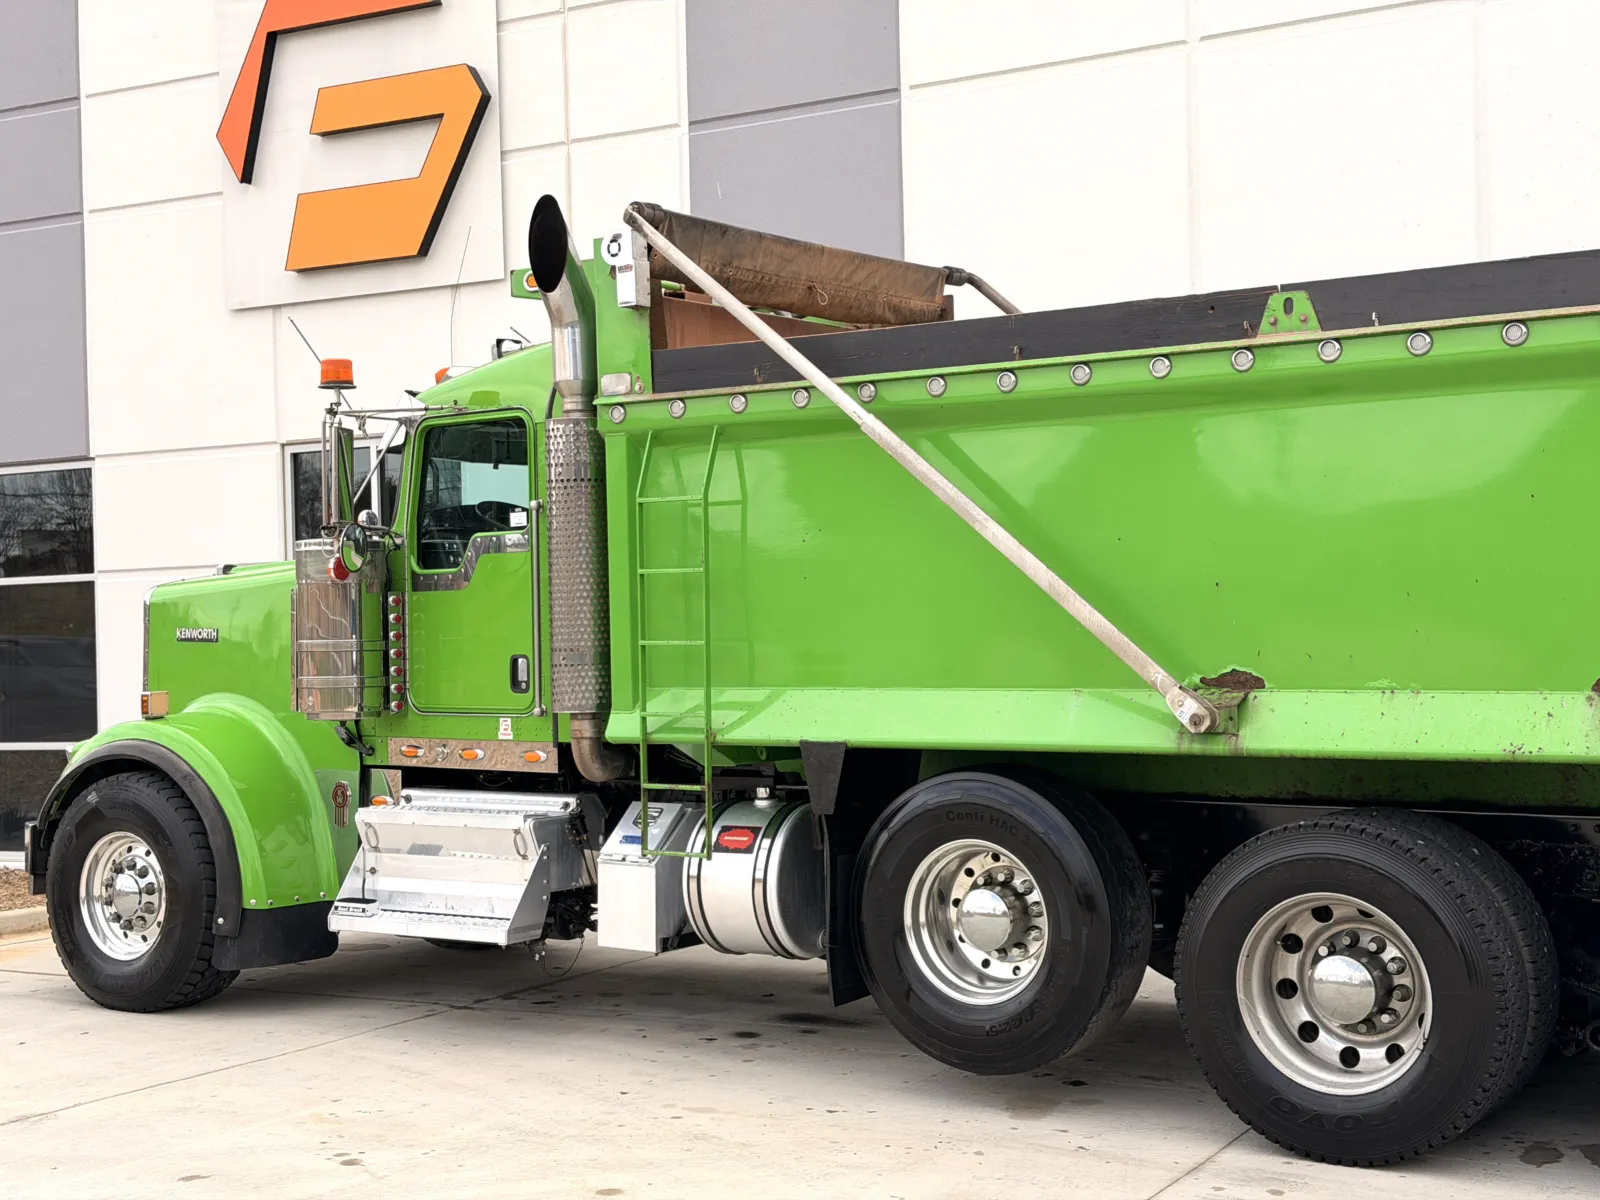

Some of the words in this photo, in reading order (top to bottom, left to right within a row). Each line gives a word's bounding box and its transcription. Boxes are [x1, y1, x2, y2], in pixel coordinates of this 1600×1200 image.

[176, 627, 217, 640] KENWORTH
[946, 810, 984, 822] Conti
[989, 814, 1018, 836] HAC
